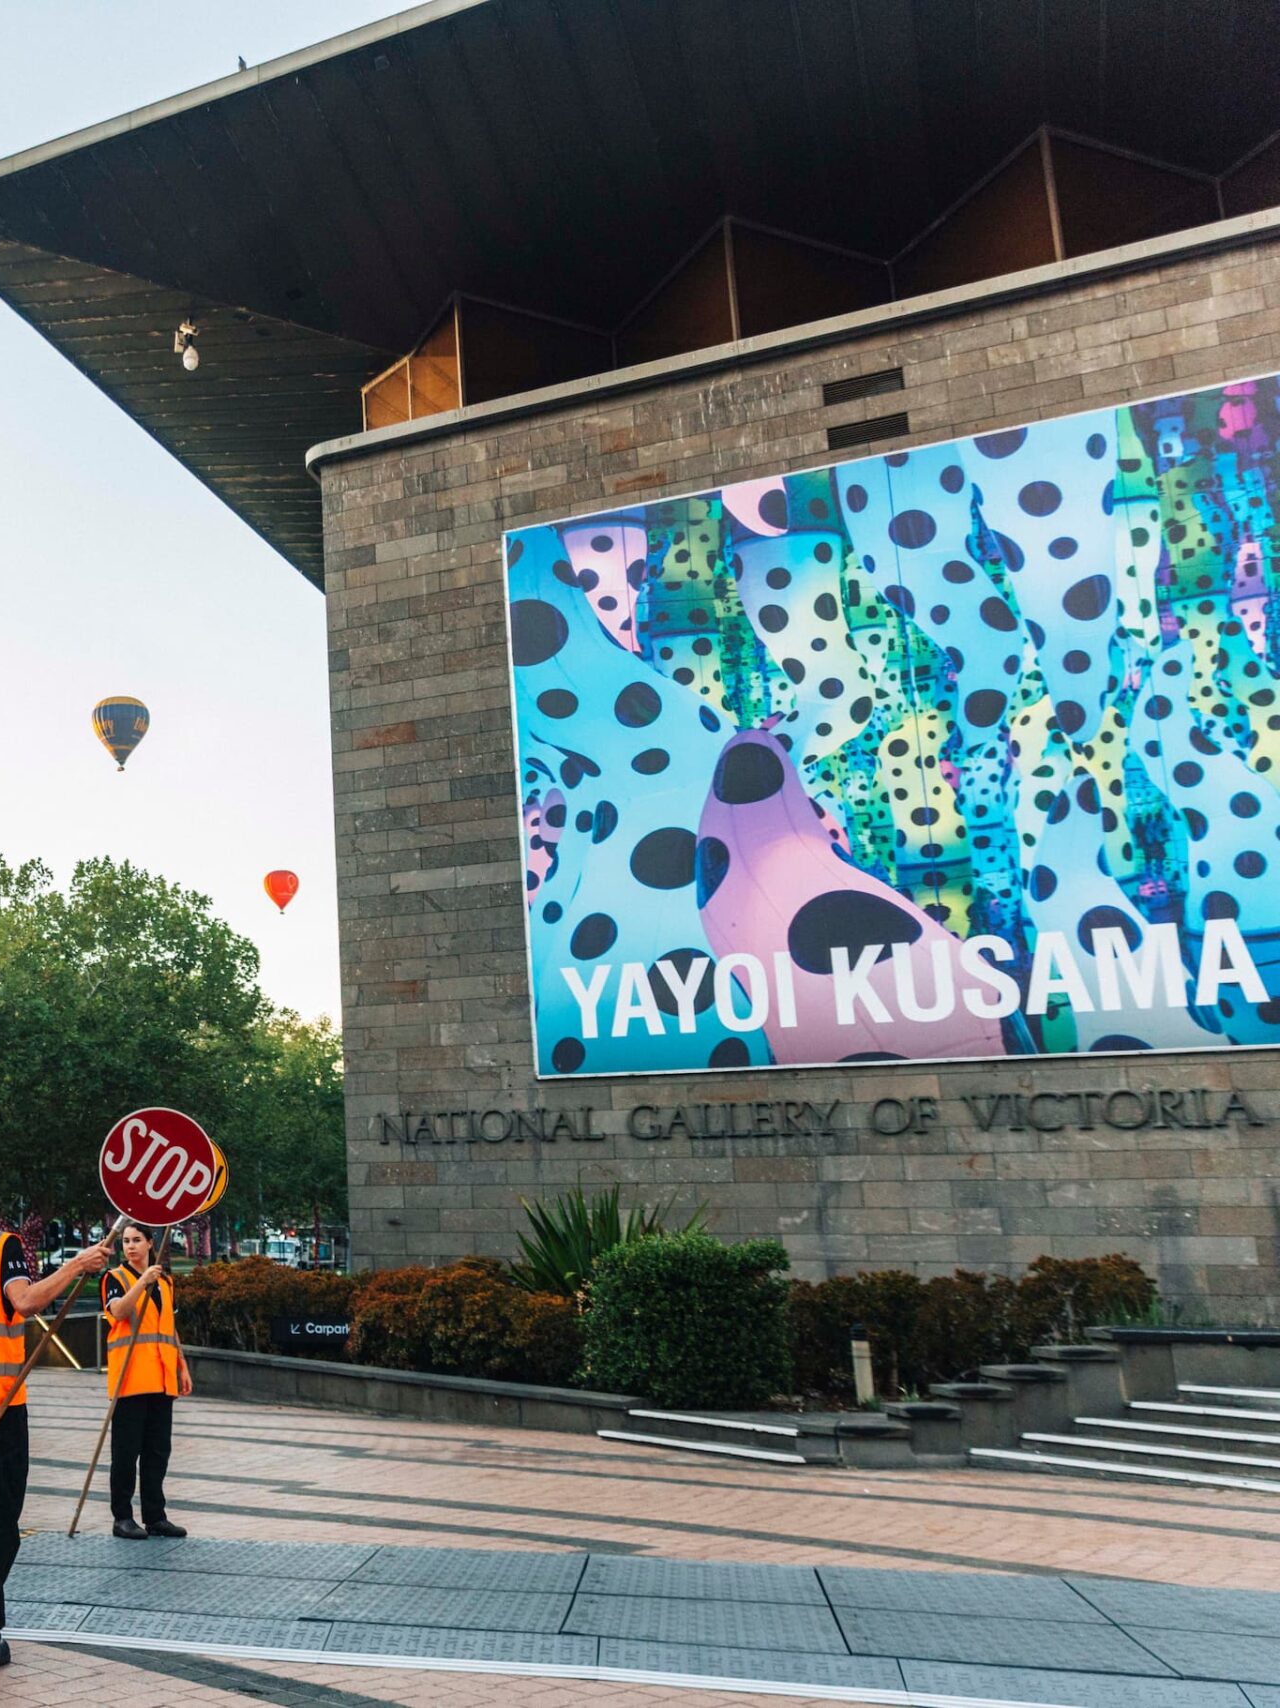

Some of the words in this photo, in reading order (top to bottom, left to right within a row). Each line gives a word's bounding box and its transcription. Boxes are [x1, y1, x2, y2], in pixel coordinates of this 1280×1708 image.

[560, 951, 798, 1039] YAYOI
[830, 918, 1272, 1025] KUSAMA
[377, 1106, 606, 1145] NATIONAL
[625, 1099, 841, 1141] GALLERY
[870, 1097, 938, 1136] OF
[960, 1088, 1266, 1132] VICTORIA
[104, 1118, 212, 1211] STOP
[8, 1260, 28, 1269] NGV
[305, 1321, 351, 1336] Carpark
